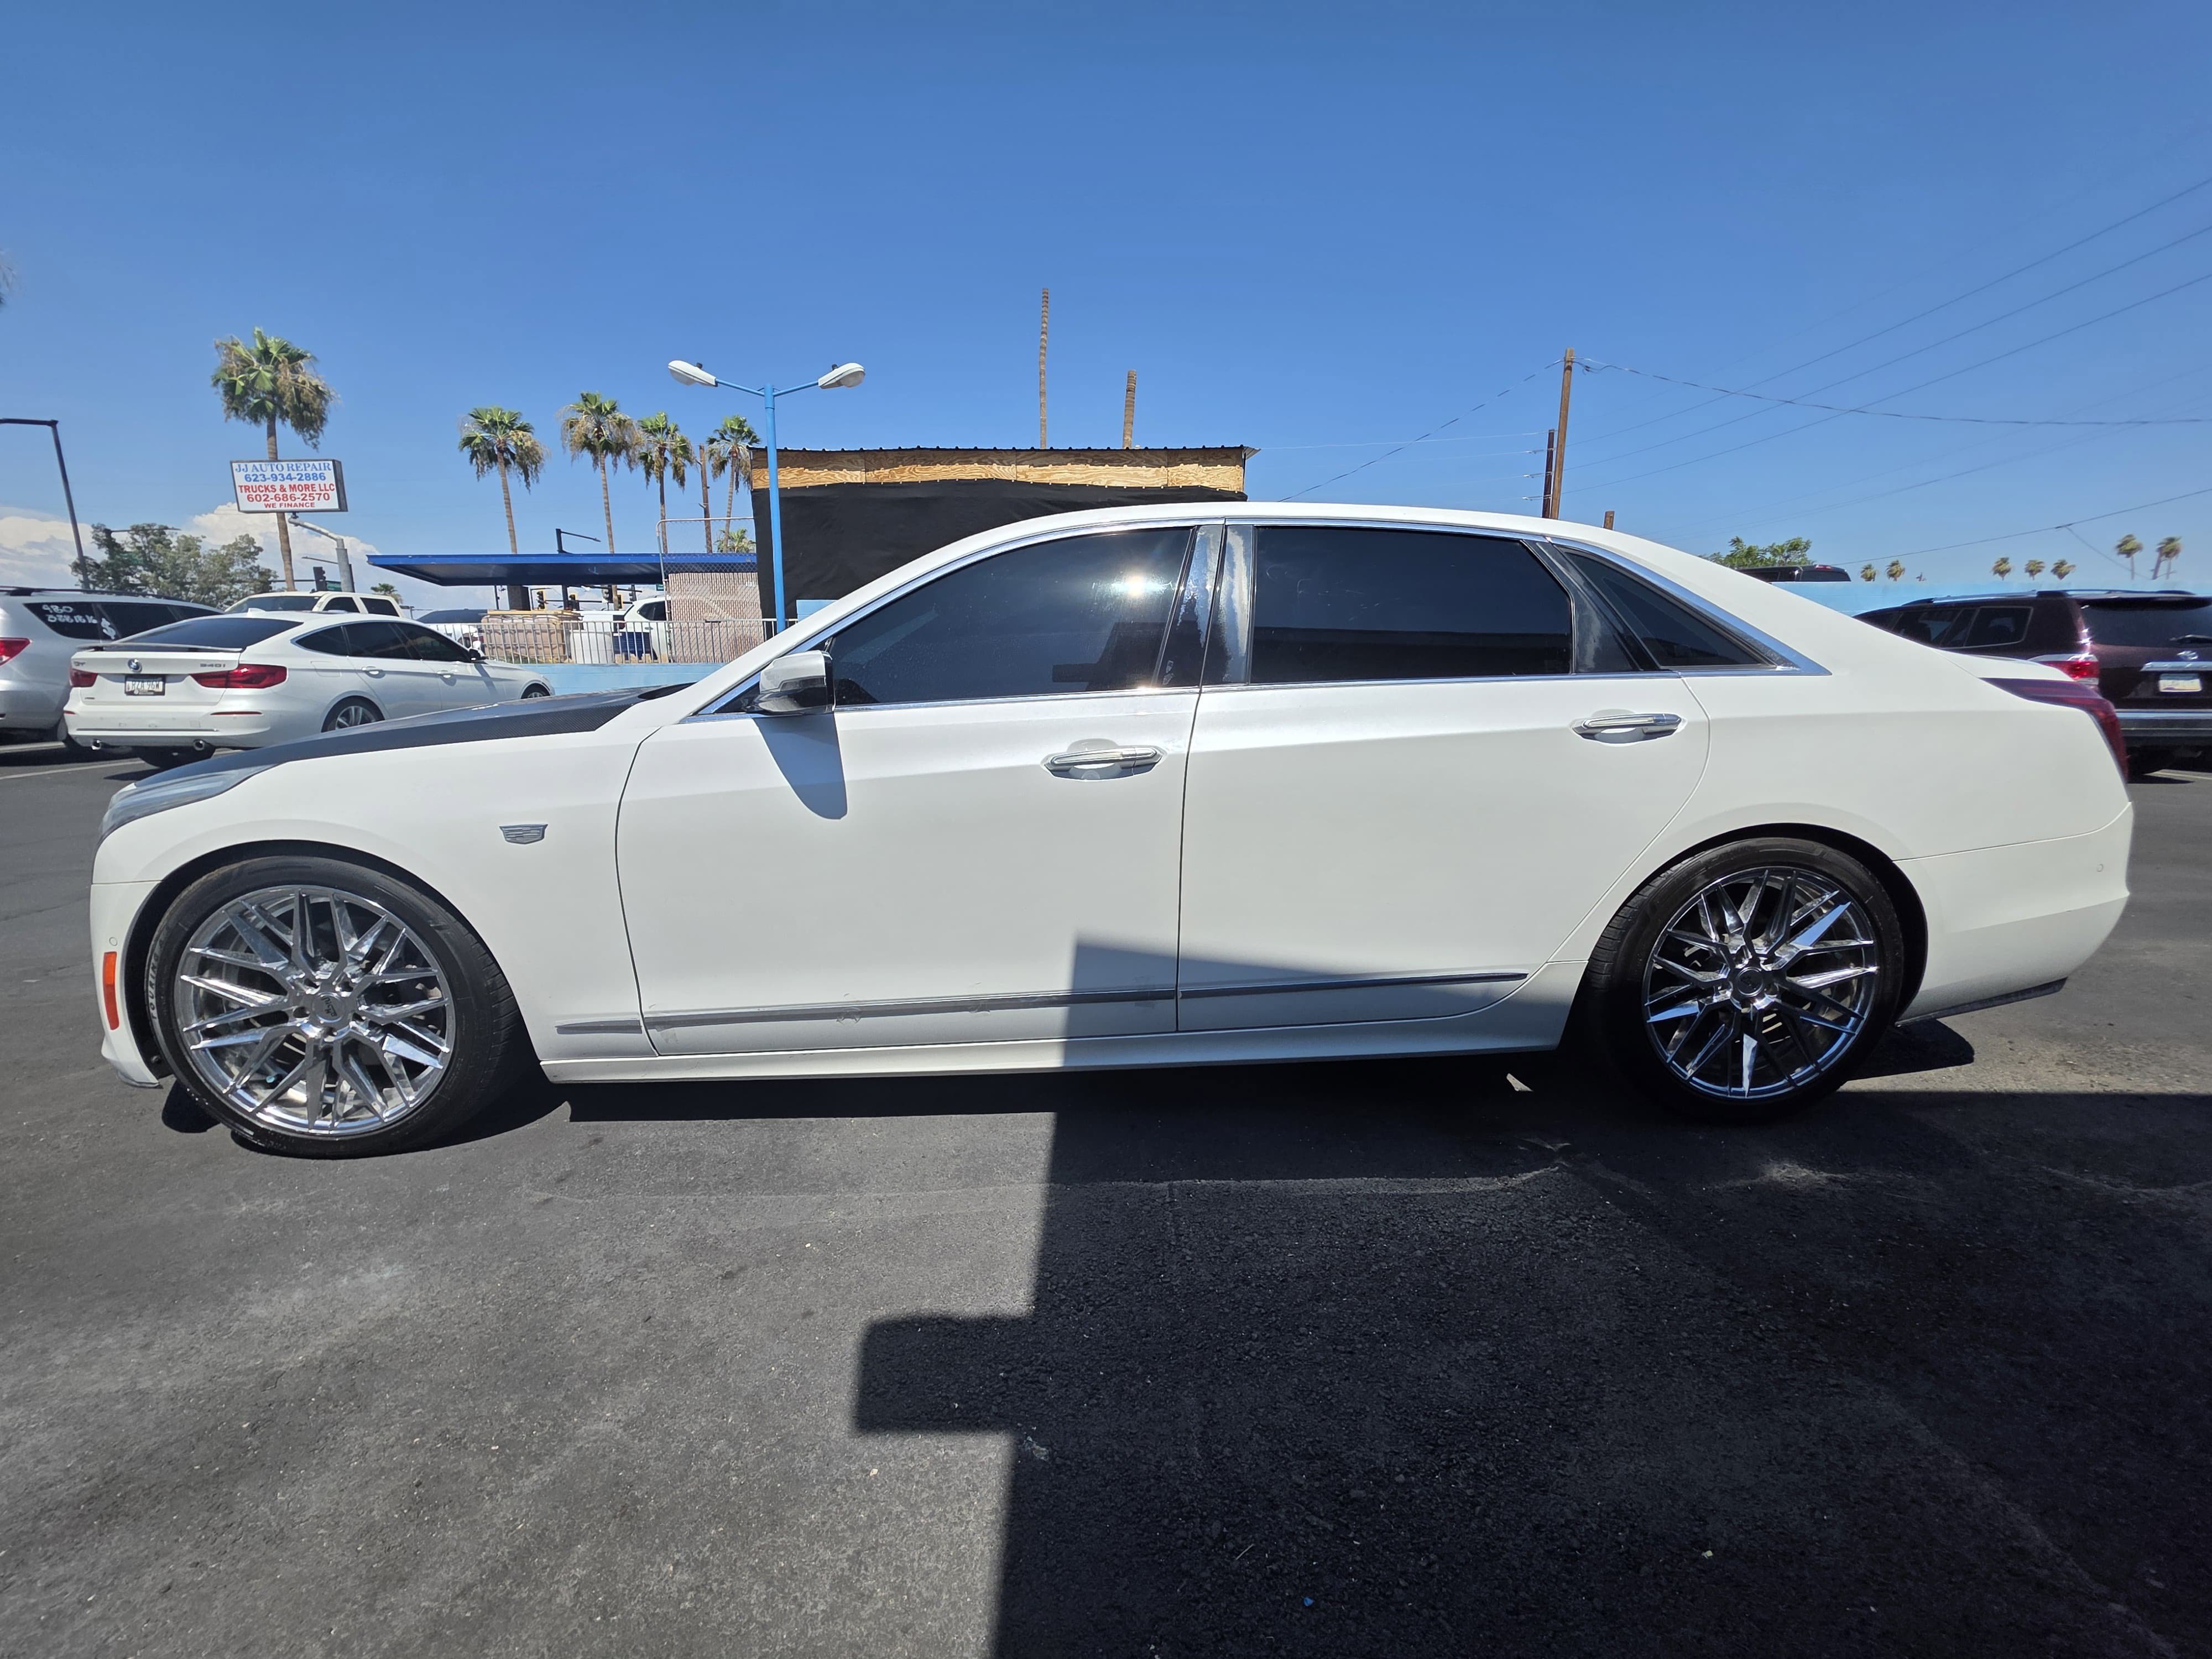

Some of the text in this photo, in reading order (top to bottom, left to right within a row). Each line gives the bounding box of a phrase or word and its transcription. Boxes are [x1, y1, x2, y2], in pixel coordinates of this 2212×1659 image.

[236, 462, 331, 472] JJ AUTO REPAIR
[244, 473, 326, 482] 623-934-2886
[238, 484, 276, 493] TRUCKS
[289, 484, 316, 492] MORE
[319, 483, 335, 492] LLC
[247, 493, 330, 502] 602-686-2570
